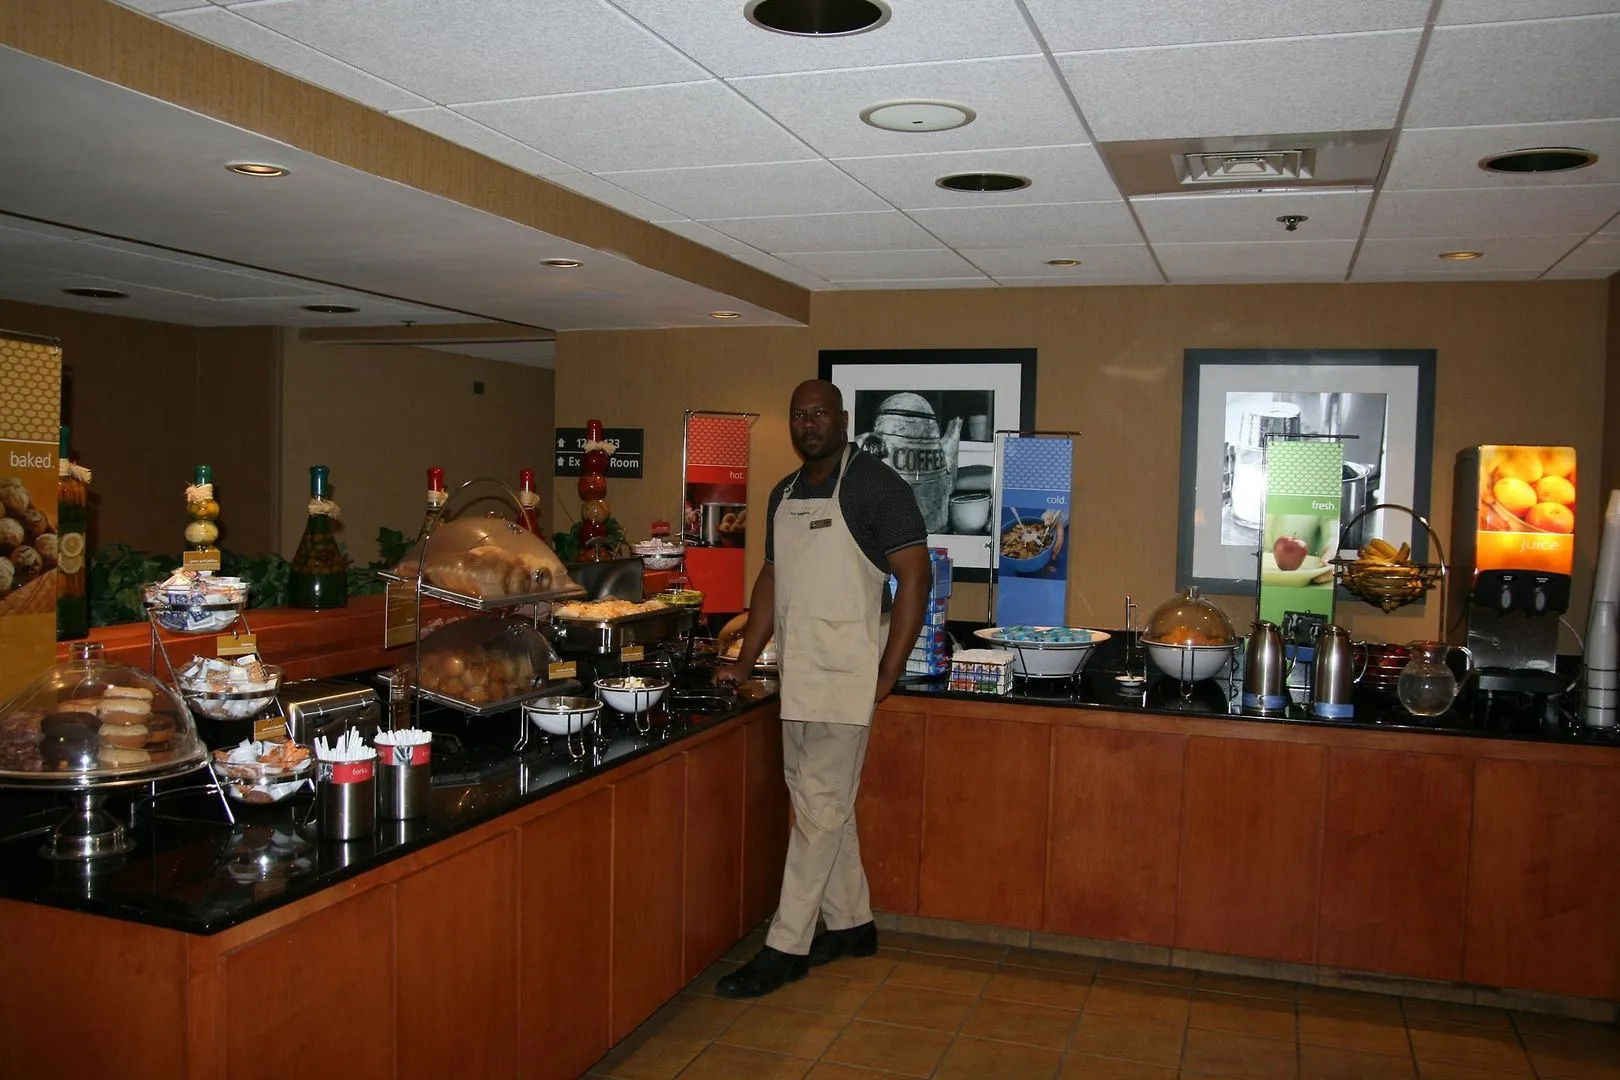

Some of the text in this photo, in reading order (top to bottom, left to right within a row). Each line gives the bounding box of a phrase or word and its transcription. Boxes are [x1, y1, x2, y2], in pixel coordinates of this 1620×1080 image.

[10, 450, 55, 469] baked.
[610, 457, 639, 468] Room
[893, 447, 946, 471] COFFEE
[1046, 495, 1067, 505] cold.
[1311, 500, 1337, 511] fresh.
